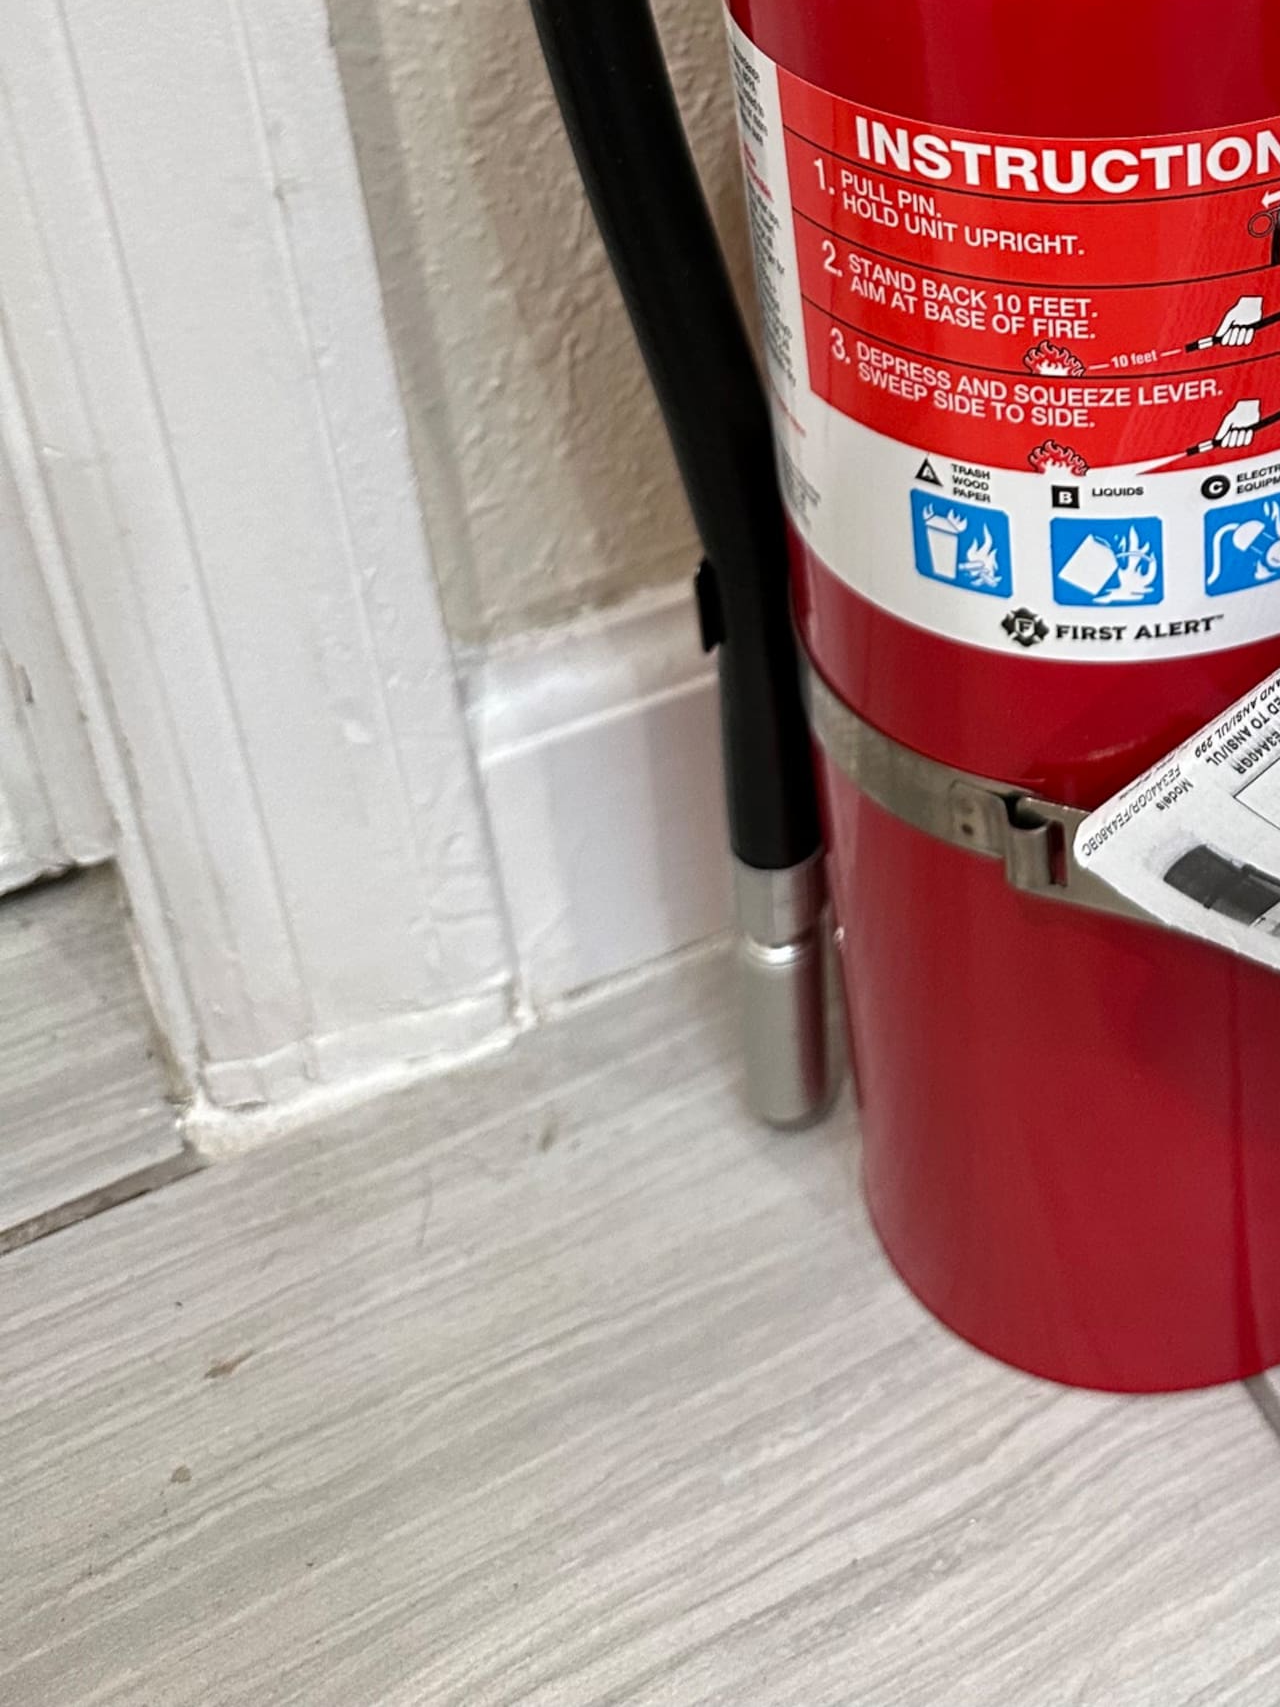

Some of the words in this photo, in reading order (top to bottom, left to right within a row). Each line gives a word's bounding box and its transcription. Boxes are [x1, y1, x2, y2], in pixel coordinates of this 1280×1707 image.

[813, 157, 836, 195] 1.
[841, 169, 893, 206] PULL
[898, 190, 942, 218] PIN.
[843, 194, 899, 228] HOLD
[904, 214, 958, 242] UNIT
[964, 226, 1085, 255] UPRIGHT.
[822, 240, 844, 278] 2.
[849, 254, 916, 293] STAND
[922, 279, 988, 310] BACK
[993, 293, 1021, 313] 10
[1028, 295, 1099, 319] FEET.
[850, 278, 886, 305] AIM
[890, 292, 916, 315] AT
[924, 302, 986, 331] BASE
[991, 314, 1026, 335] OF
[1033, 318, 1096, 340] FIRE.
[830, 327, 851, 365] 3.
[856, 339, 951, 390] DEPRESS
[957, 377, 1007, 400] AND
[1013, 384, 1131, 408] SQUEEZE
[1138, 378, 1223, 406] LEVER.
[1111, 353, 1127, 369] 10
[1130, 349, 1157, 367] feet
[857, 366, 928, 401] SWEEP
[933, 387, 986, 417] SIDE
[991, 405, 1025, 424] TO
[1031, 408, 1095, 428] SIDE.
[951, 463, 992, 480] TRASH
[951, 475, 990, 492] WOOD
[952, 488, 992, 503] PAPER
[1091, 486, 1144, 498] LIQUIDS
[1055, 624, 1126, 641] FIRST
[1249, 711, 1271, 730] TO
[1205, 725, 1253, 767] ANSI/UL
